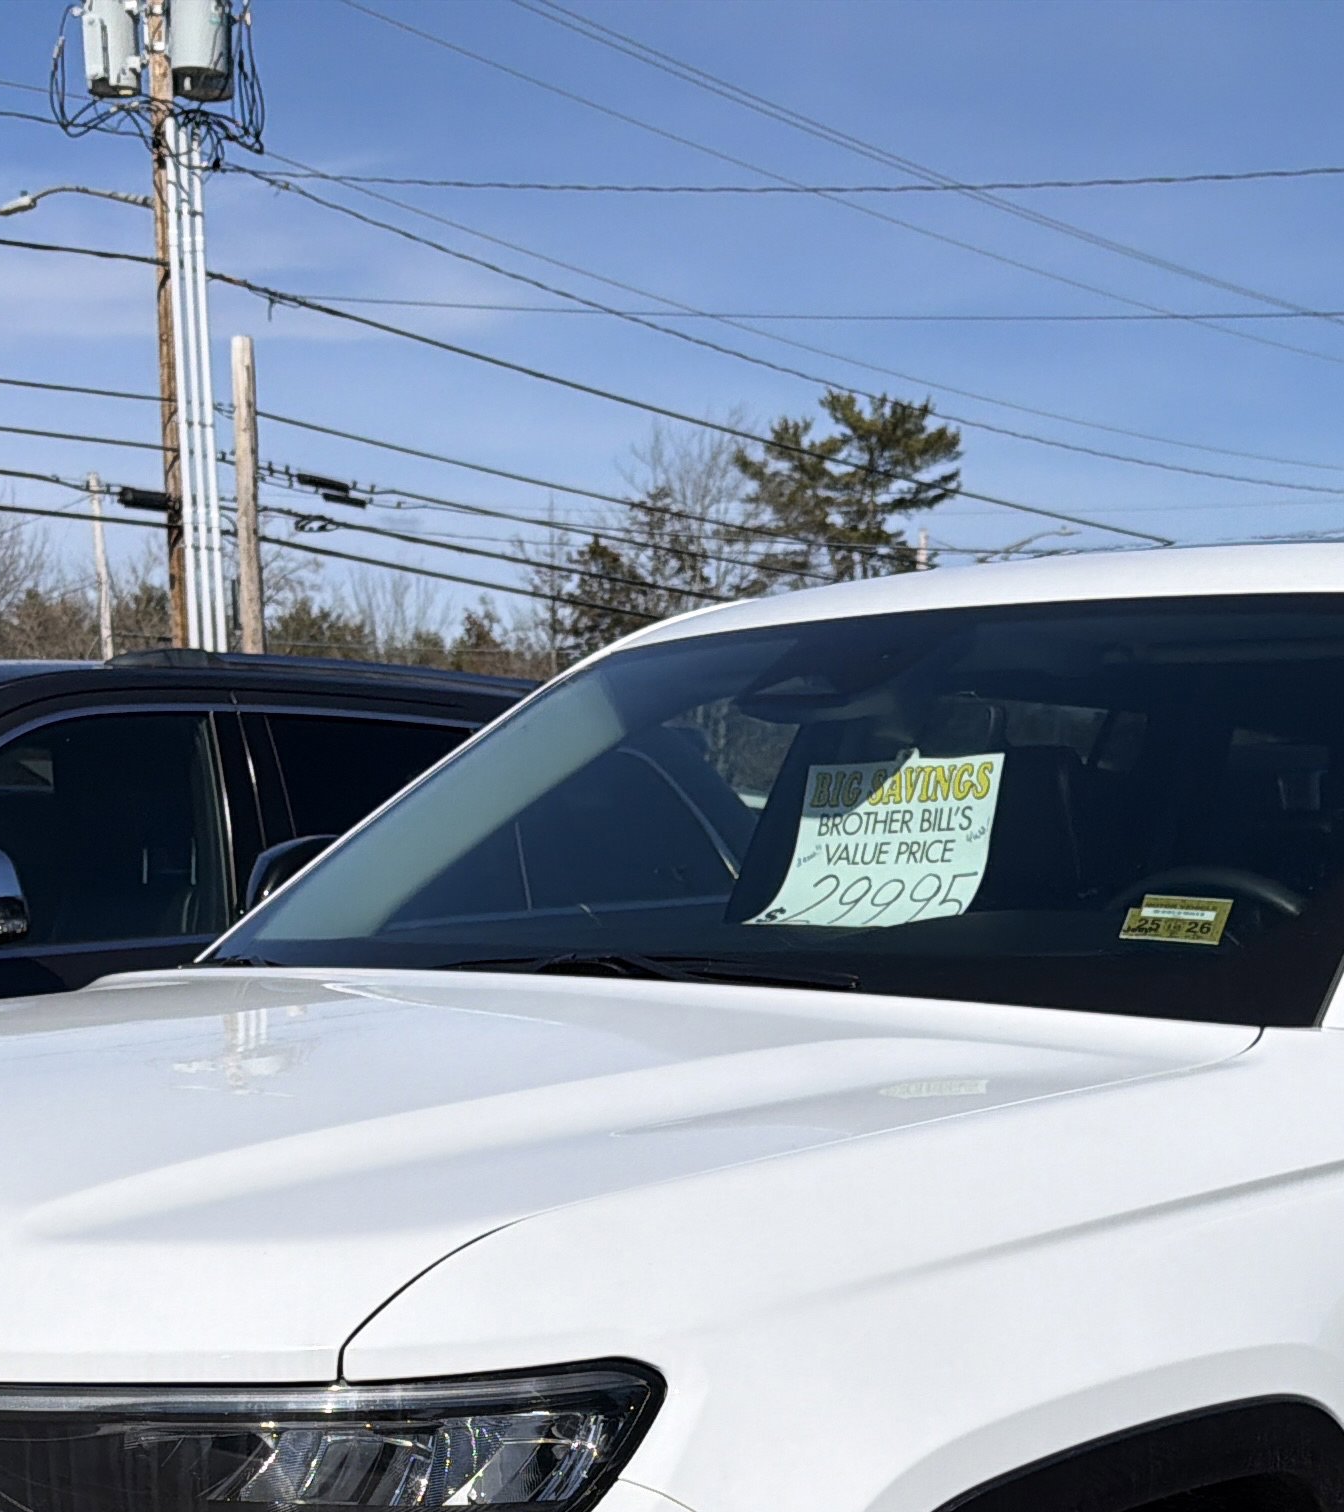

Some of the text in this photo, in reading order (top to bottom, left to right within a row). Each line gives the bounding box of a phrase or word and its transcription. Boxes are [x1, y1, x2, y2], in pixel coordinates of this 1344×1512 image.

[809, 761, 994, 808] BIG SAVINGS
[817, 805, 973, 837] BROTHER BILL'S
[824, 841, 891, 867] VALUE
[894, 839, 956, 865] PRICE
[1184, 921, 1212, 935] 26
